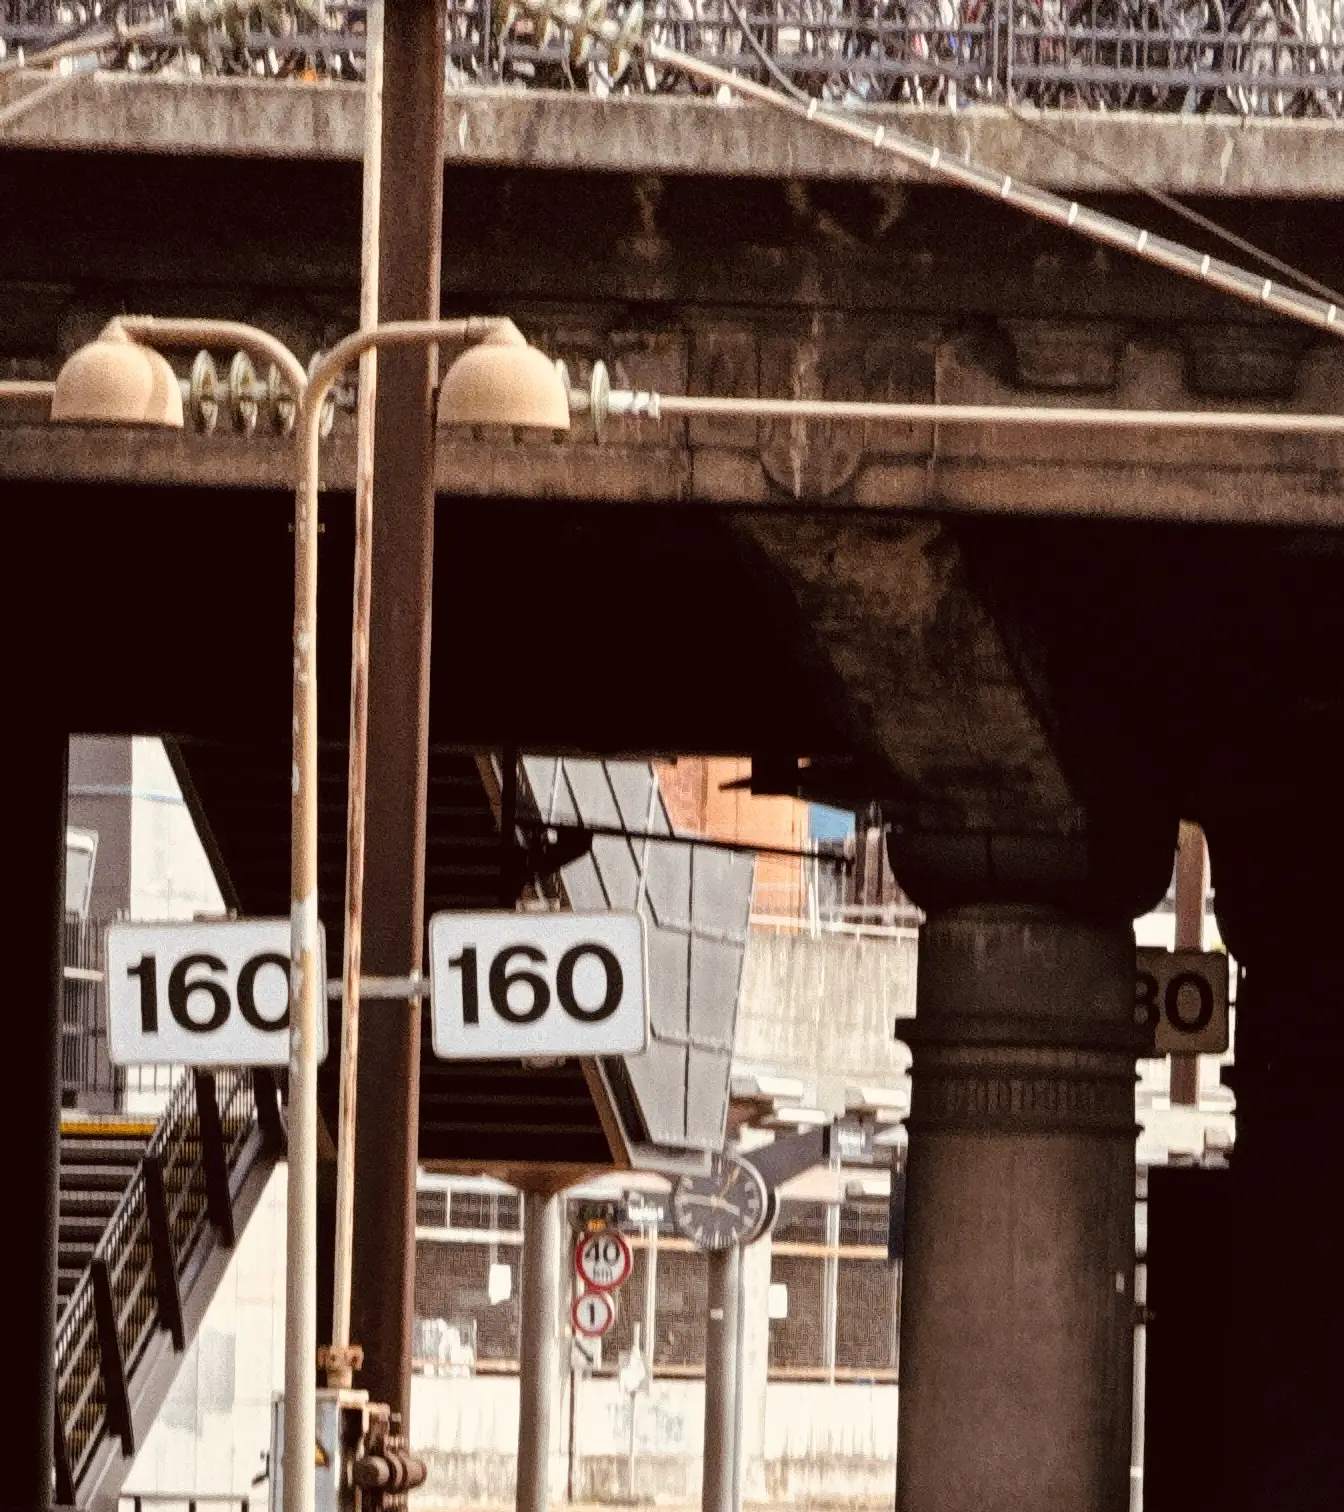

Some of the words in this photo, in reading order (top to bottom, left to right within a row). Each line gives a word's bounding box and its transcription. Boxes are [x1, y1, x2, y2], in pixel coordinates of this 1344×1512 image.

[126, 951, 291, 1035] 160
[448, 942, 624, 1027] 160
[585, 1239, 620, 1265] 40
